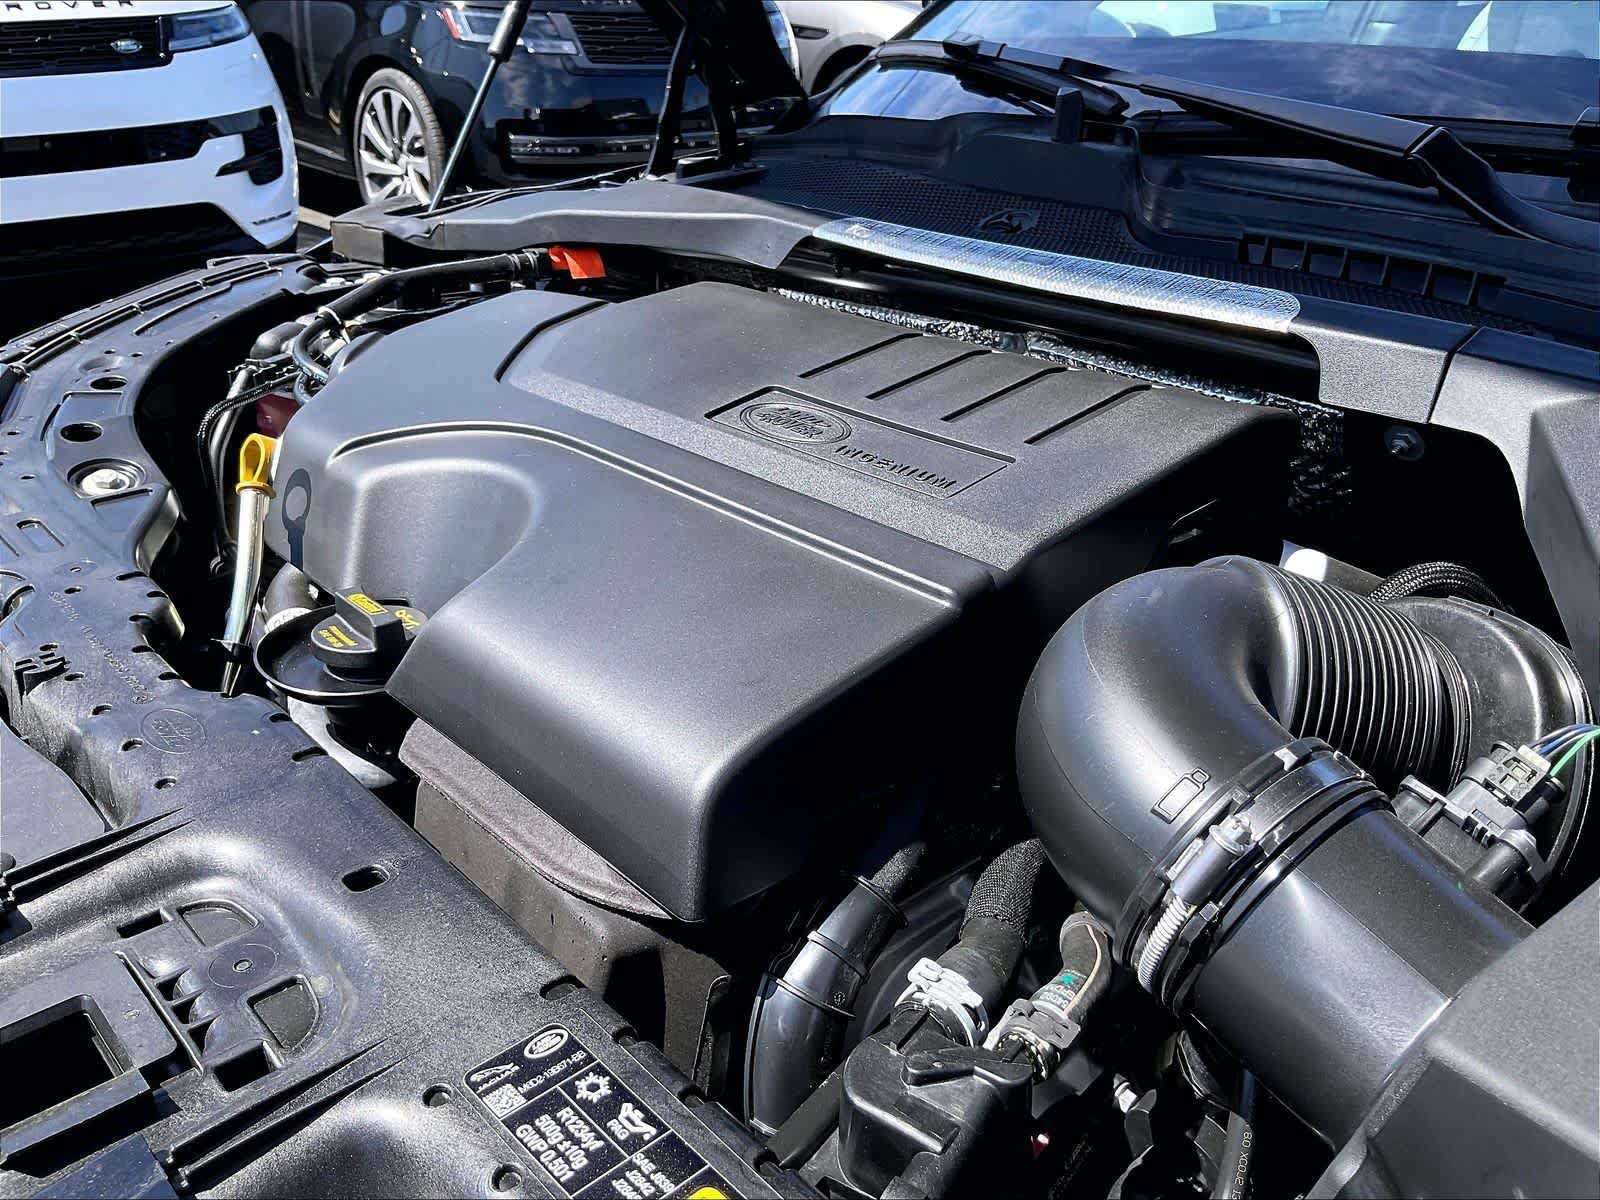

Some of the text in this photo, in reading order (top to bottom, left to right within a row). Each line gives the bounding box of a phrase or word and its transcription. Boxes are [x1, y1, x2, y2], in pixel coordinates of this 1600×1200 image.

[756, 412, 824, 438] ROVER
[834, 445, 958, 490] INGENIUM
[476, 1065, 520, 1094] JAGUAR
[535, 1114, 589, 1170] 500g ±10g
[556, 1106, 605, 1151] R1234yf
[606, 1118, 630, 1141] PAG
[515, 1124, 575, 1182] GWP 0.501
[632, 1152, 676, 1194] SAE J639
[625, 1169, 656, 1197] J2842
